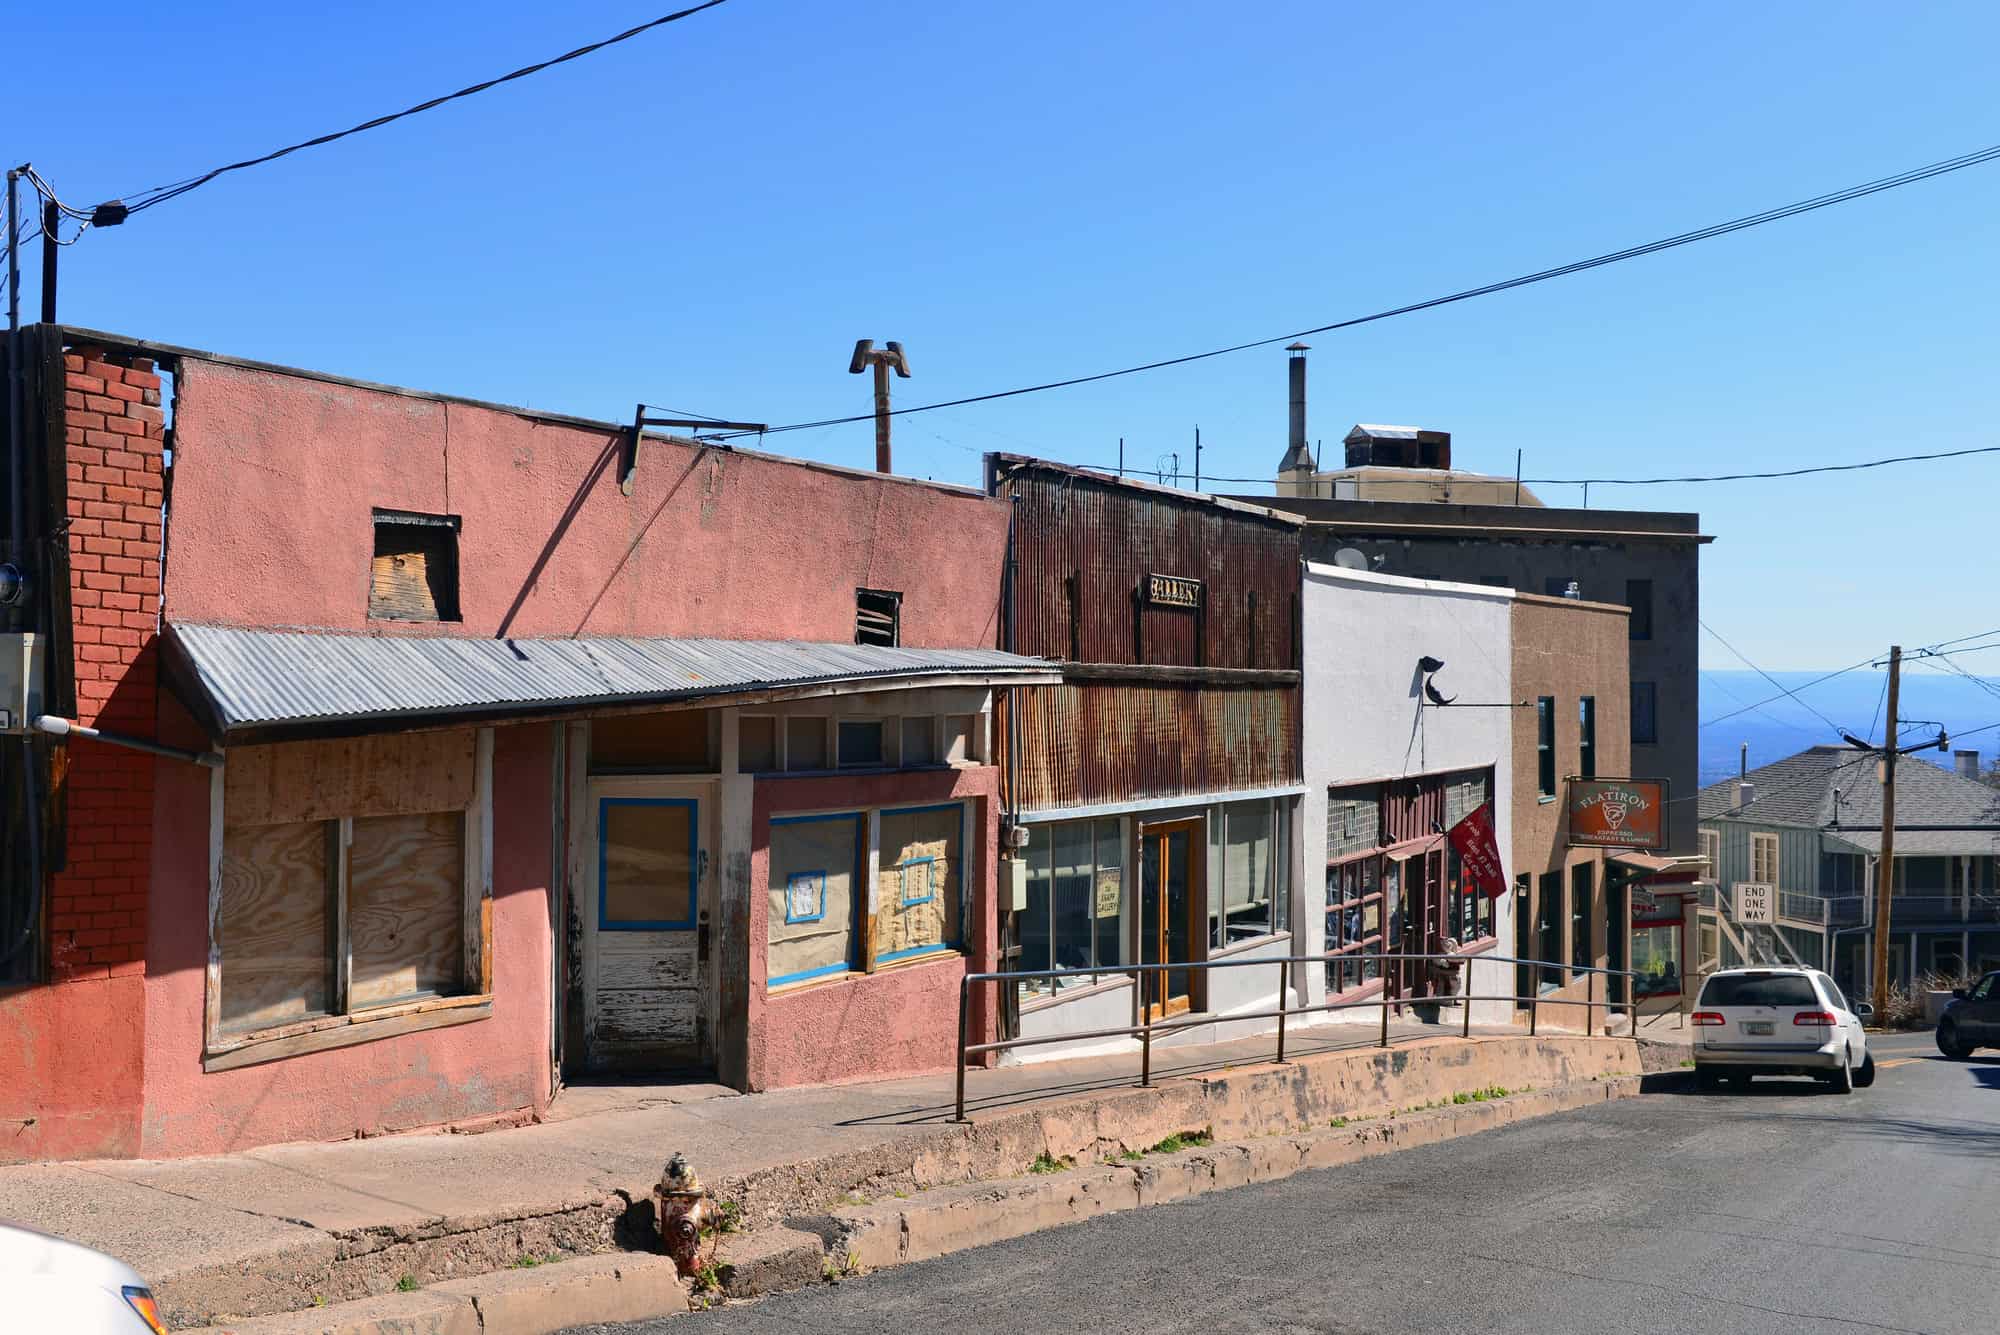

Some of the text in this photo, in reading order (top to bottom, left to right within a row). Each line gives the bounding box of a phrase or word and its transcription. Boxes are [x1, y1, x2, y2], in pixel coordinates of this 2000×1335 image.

[1151, 577, 1200, 607] GALLERY
[1580, 791, 1650, 810] FLATIRON
[1745, 887, 1765, 897] END
[1745, 898, 1766, 909] ONE
[1744, 910, 1766, 921] WAY
